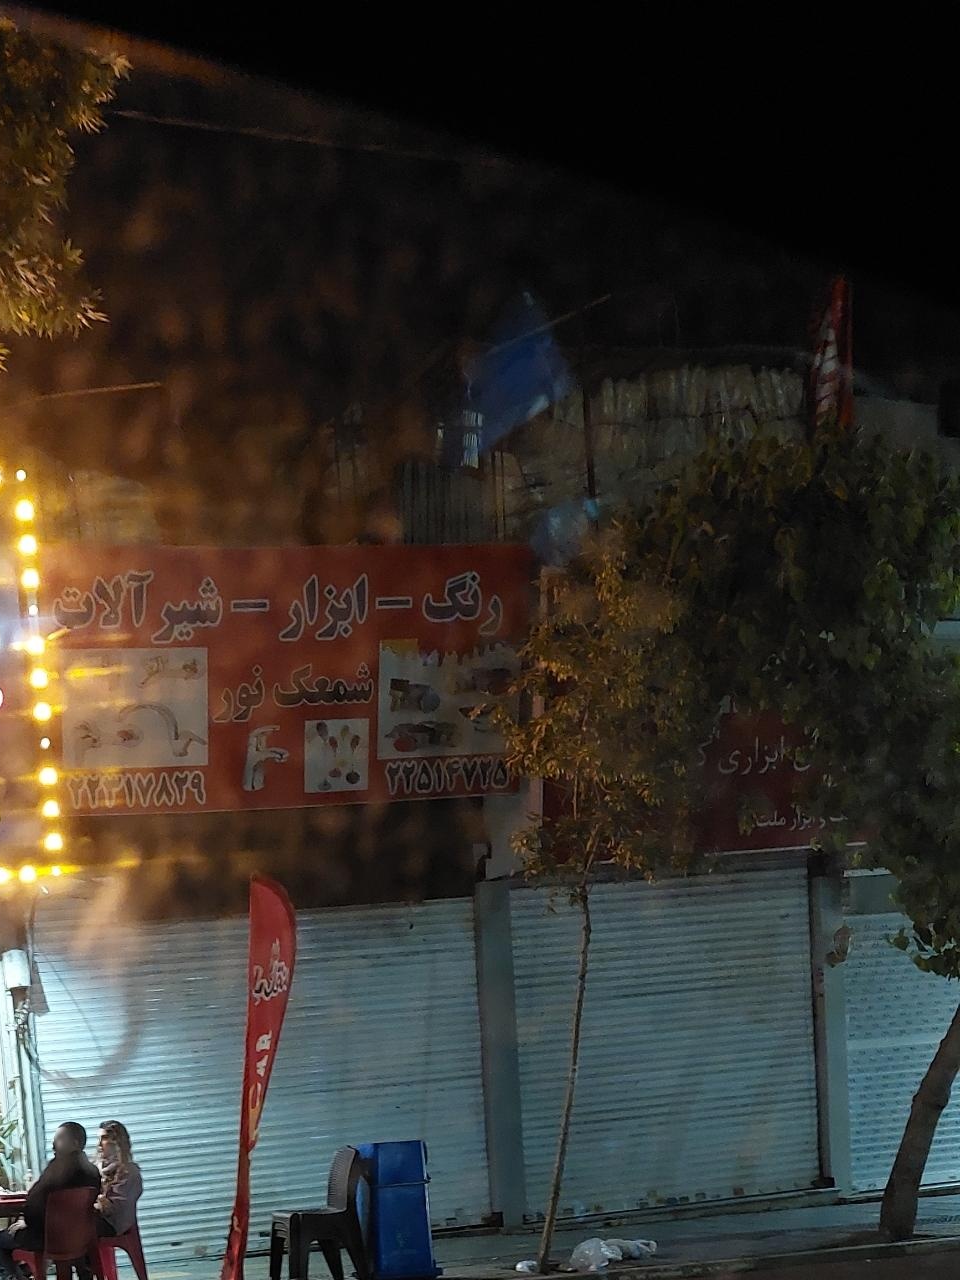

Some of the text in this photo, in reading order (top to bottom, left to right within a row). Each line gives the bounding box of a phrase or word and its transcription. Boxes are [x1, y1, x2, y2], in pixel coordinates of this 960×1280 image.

[52, 570, 154, 630] آلات
[152, 576, 224, 644] شیر
[279, 573, 369, 642] ابزار
[423, 570, 503, 636] رنگ
[212, 662, 374, 723] شمعک نور
